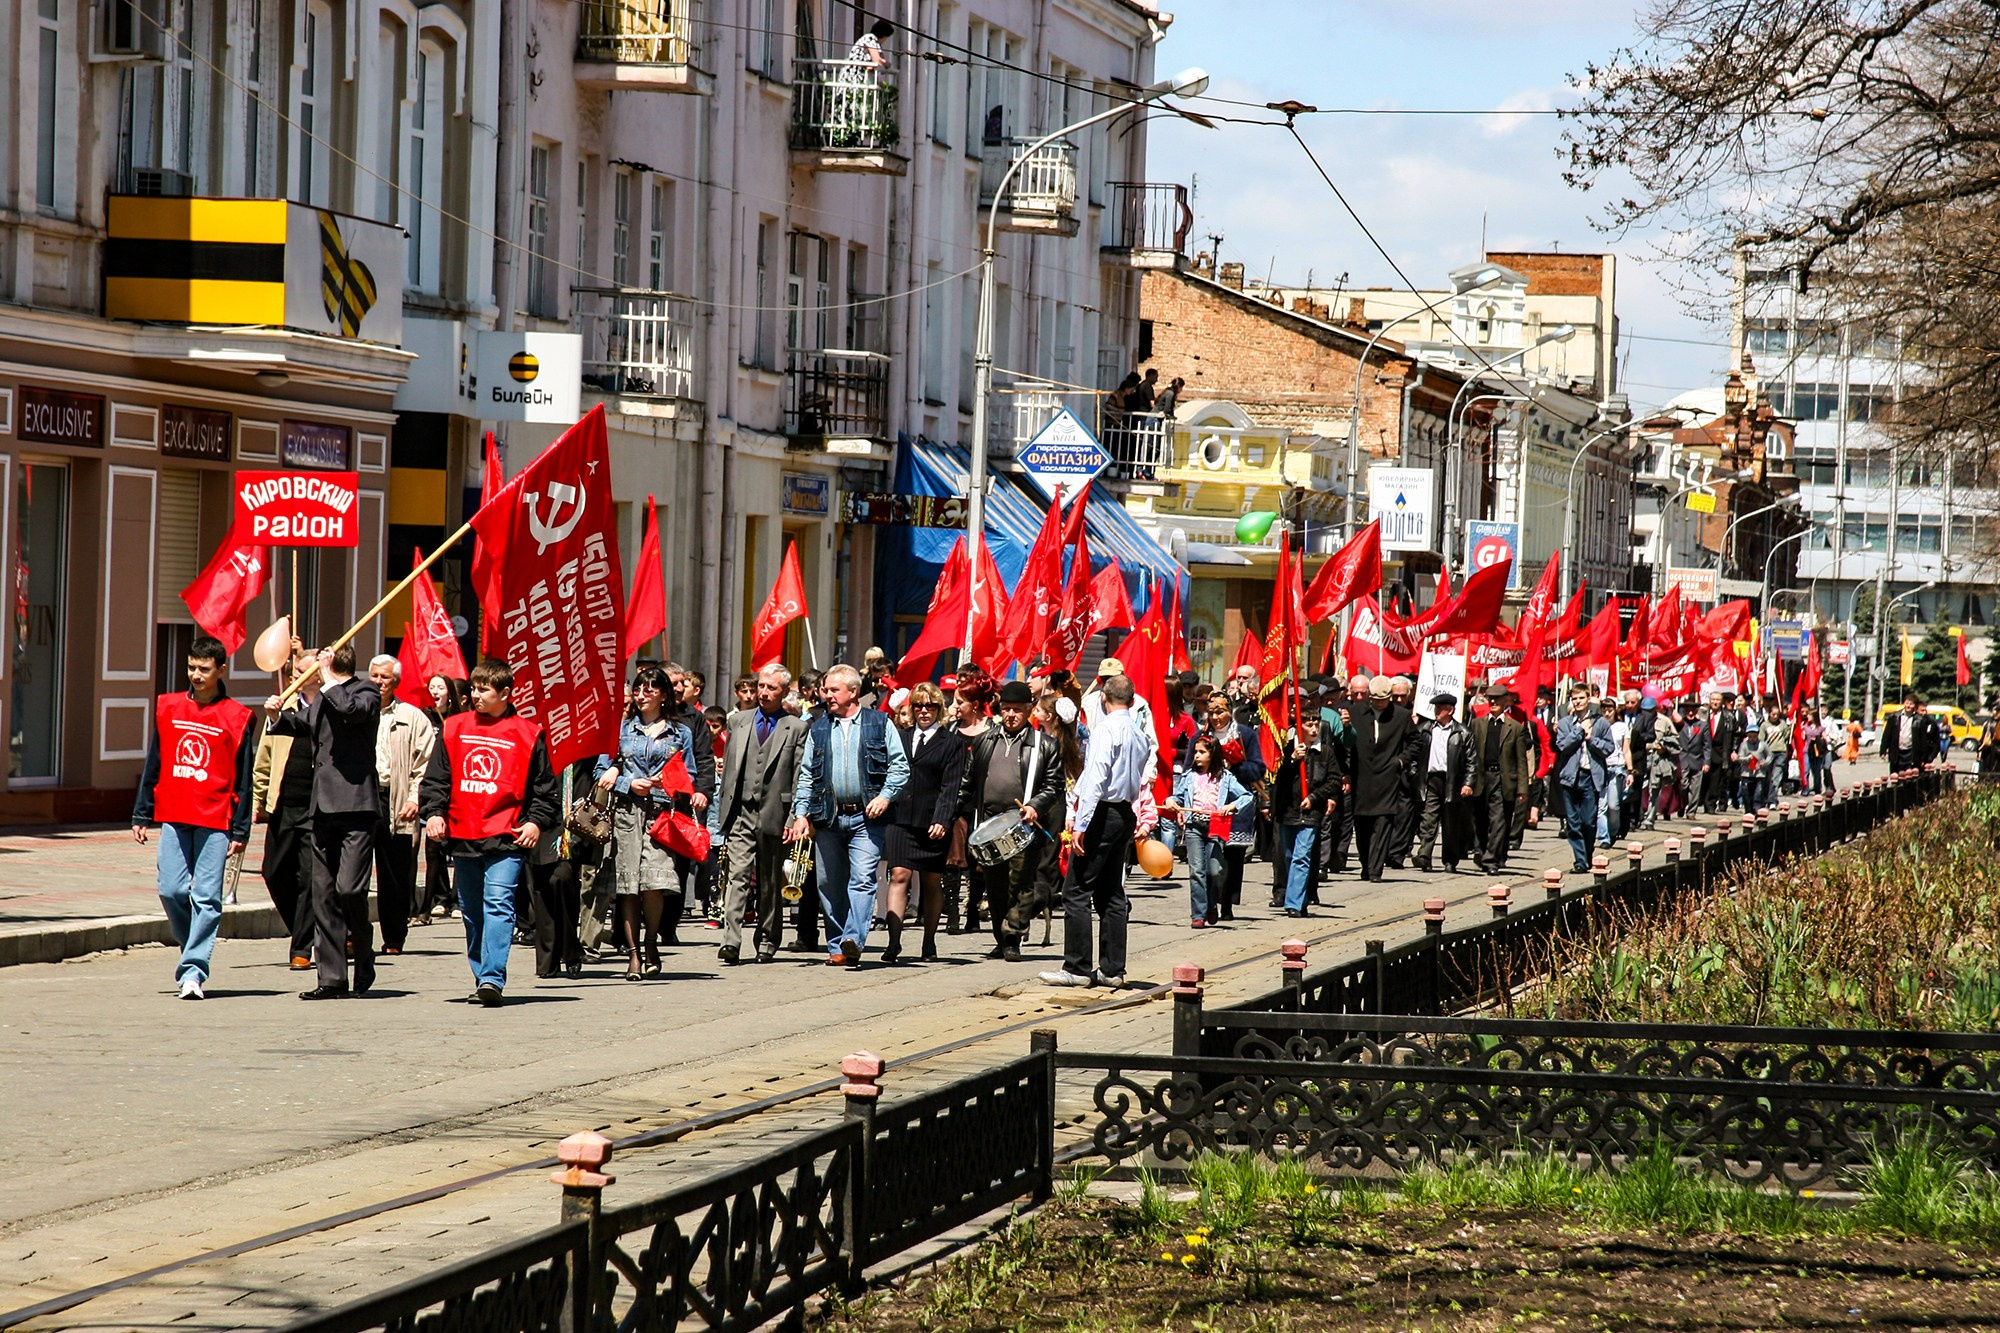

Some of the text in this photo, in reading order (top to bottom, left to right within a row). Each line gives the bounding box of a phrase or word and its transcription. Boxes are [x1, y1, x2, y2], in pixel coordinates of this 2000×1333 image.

[492, 386, 553, 405] Билайн
[1027, 452, 1102, 466] ФАНТАЗИЯ
[239, 476, 355, 514] КИРОВСКИЙ
[1384, 482, 1418, 490] МАГАЗИН
[503, 597, 528, 640] 79
[172, 764, 208, 782] КПРФ
[460, 779, 498, 795] КПРФ
